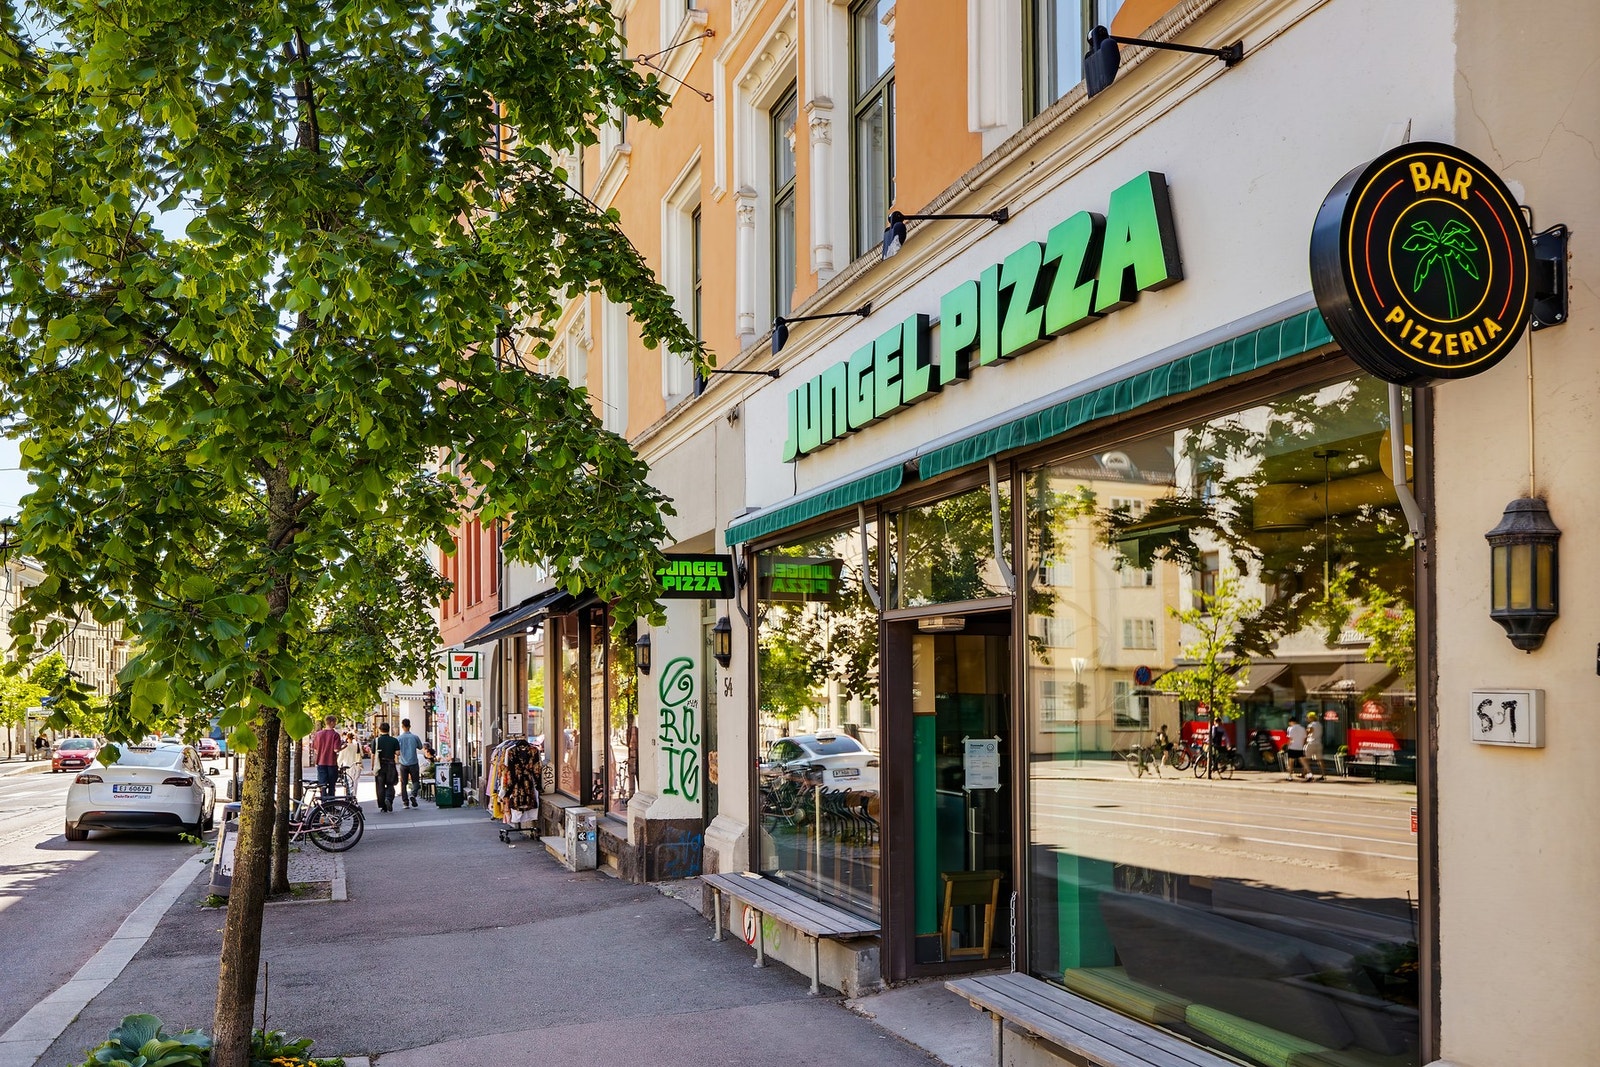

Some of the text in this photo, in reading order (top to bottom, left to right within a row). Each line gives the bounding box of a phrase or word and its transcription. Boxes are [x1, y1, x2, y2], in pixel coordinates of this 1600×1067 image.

[1408, 161, 1473, 201] BAR
[782, 170, 1175, 463] JUNGEL PIZZA
[1384, 304, 1503, 356] PIZZERIA
[662, 576, 722, 592] PIZZA
[454, 655, 474, 680] 7
